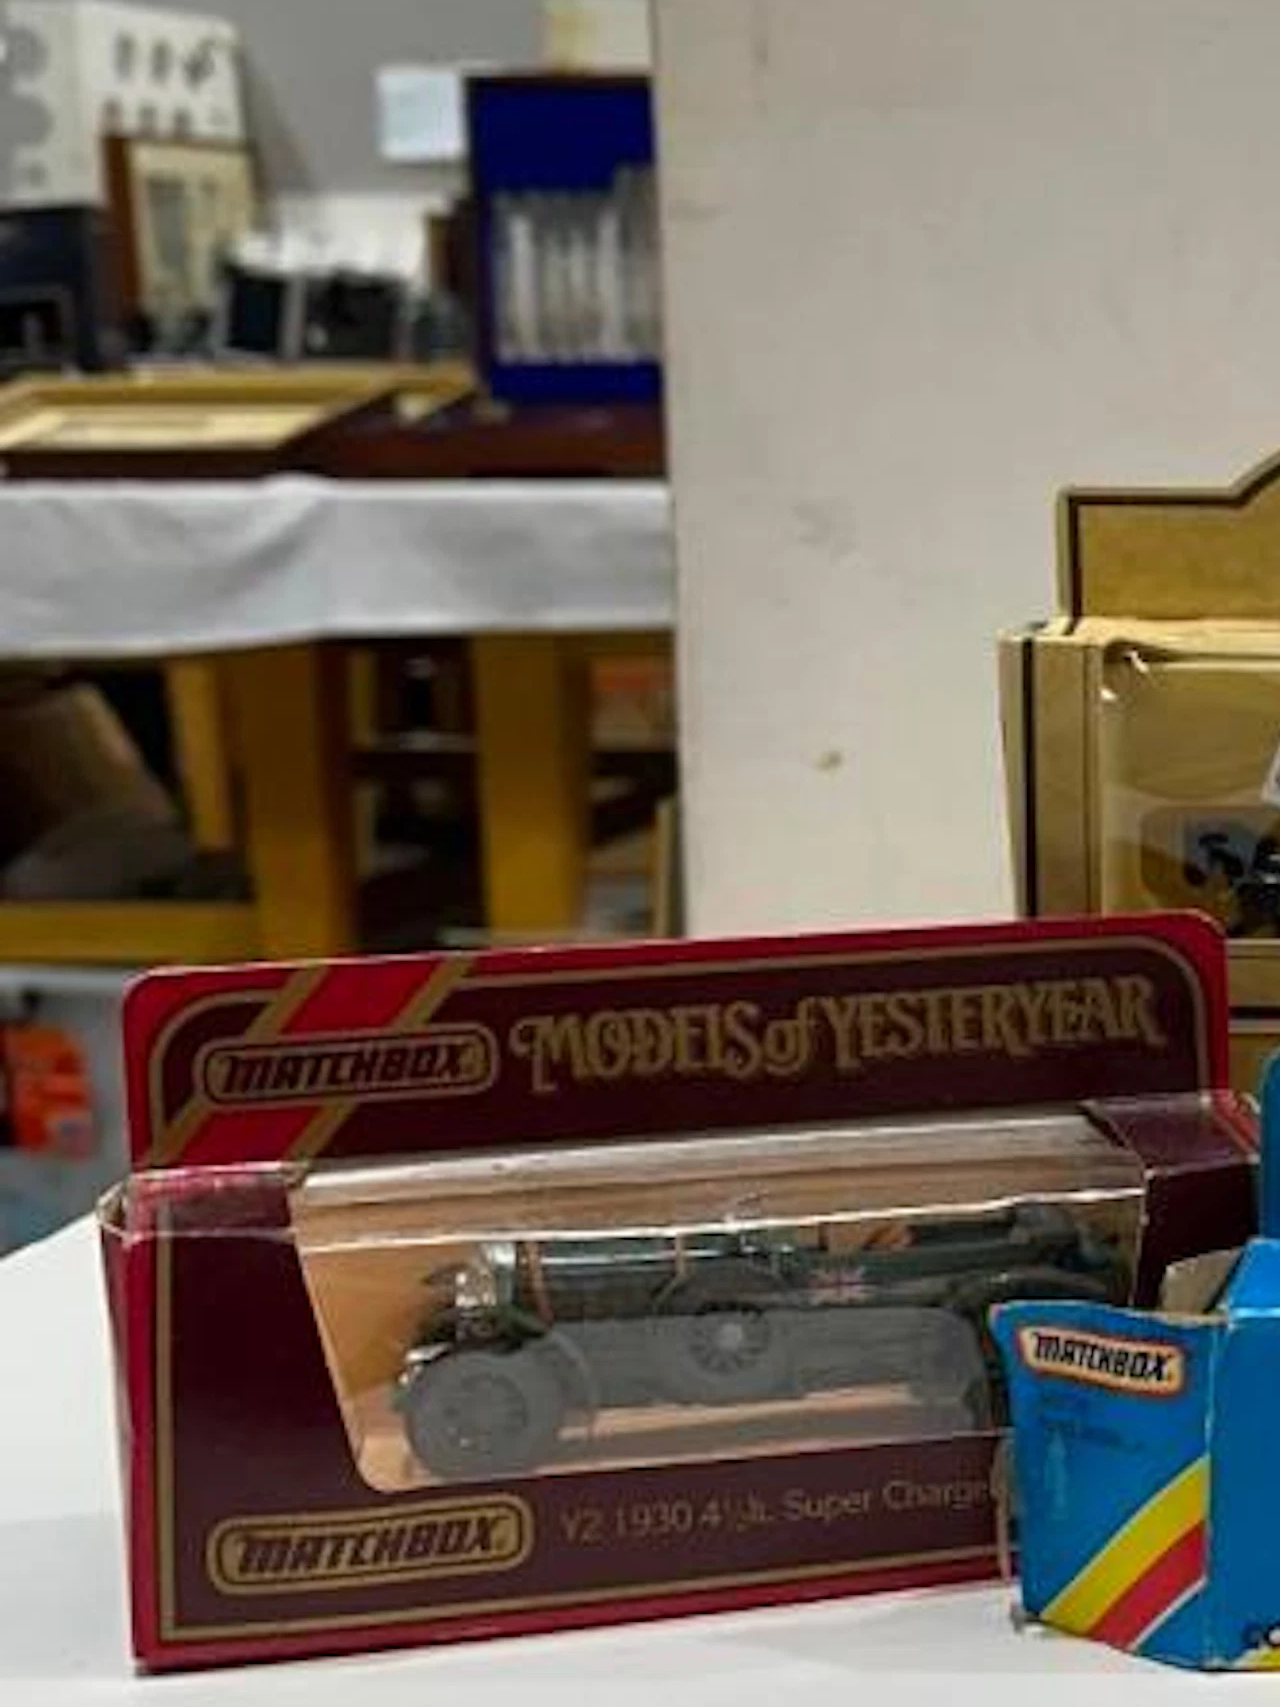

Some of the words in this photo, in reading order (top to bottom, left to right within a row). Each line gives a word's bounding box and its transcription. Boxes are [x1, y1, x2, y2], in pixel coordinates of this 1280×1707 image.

[508, 1000, 764, 1092] MODELS
[815, 975, 1165, 1071] YESTERYEAR
[222, 1038, 470, 1096] MATCHBOX
[1032, 1330, 1173, 1382] MATCHBOX
[614, 1501, 693, 1538] 1930
[780, 1488, 872, 1525] Super
[238, 1514, 508, 1575] MATCHBOX
